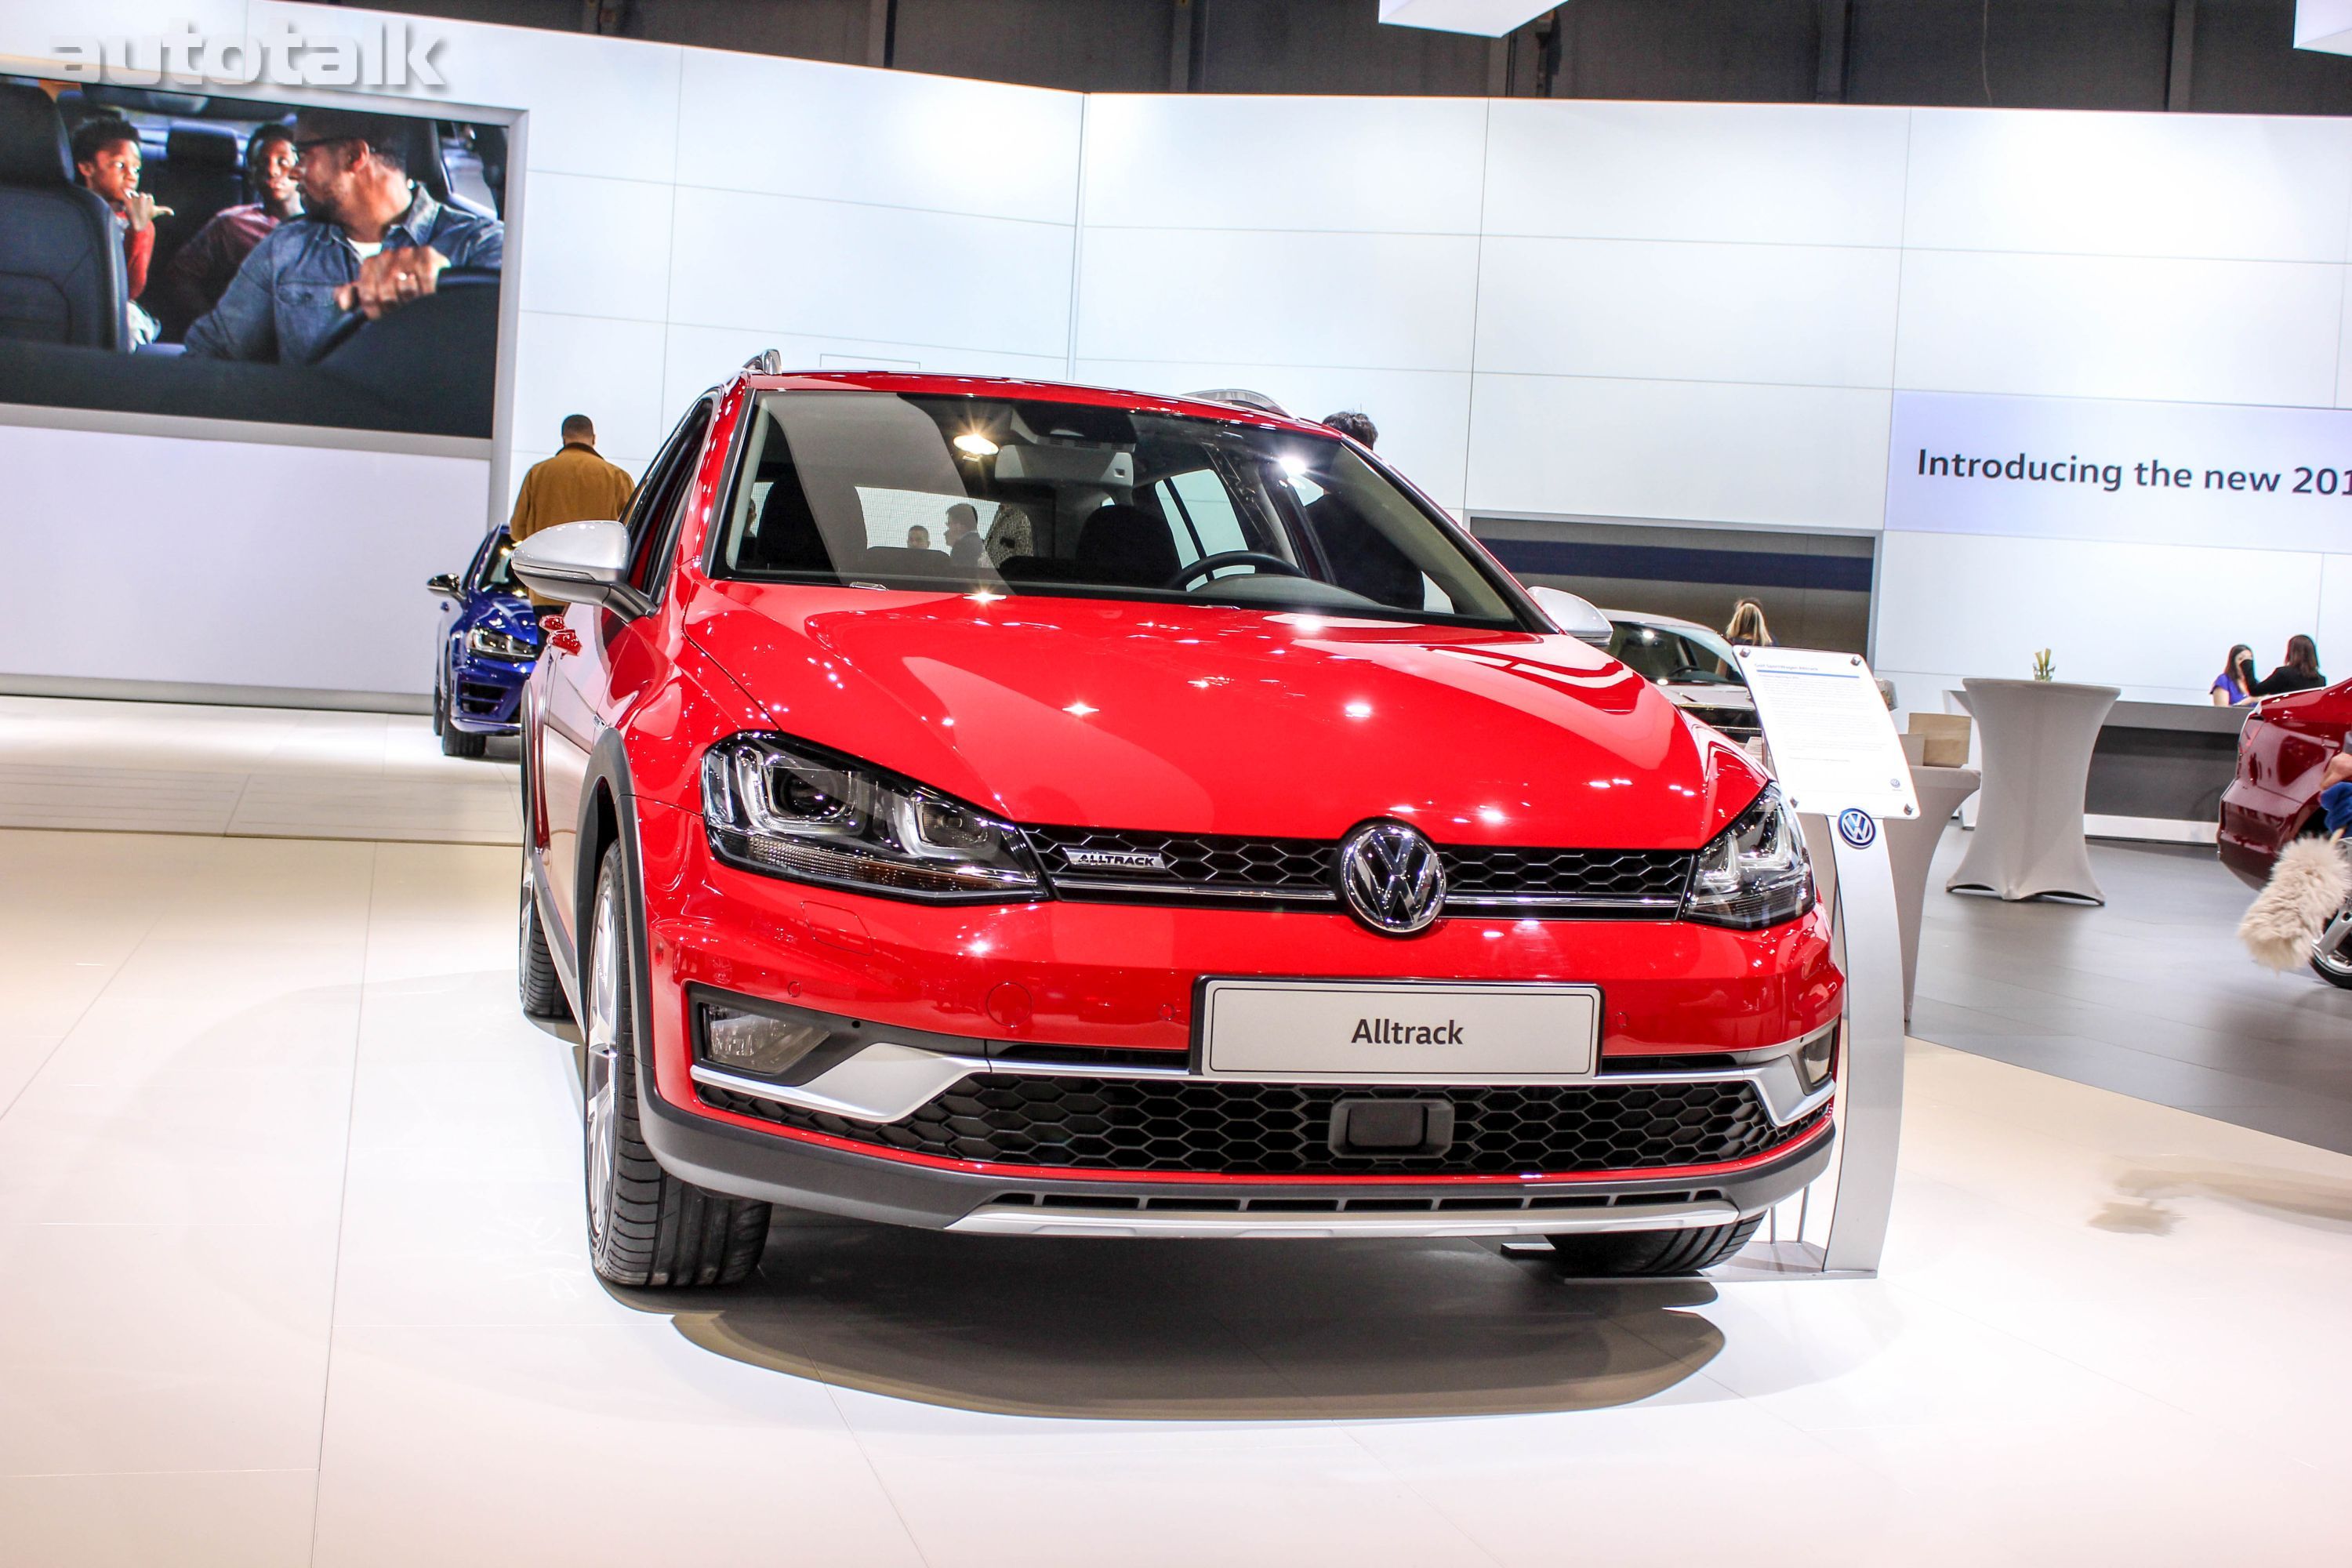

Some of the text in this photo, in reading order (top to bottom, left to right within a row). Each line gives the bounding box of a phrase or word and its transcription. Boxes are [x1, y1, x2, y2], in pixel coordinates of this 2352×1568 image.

[1918, 448, 2122, 492] Introducing
[2133, 459, 2193, 488] the
[2204, 470, 2281, 492] new
[1078, 854, 1155, 866] ALLTRACK
[1351, 1018, 1465, 1045] Alltrack
